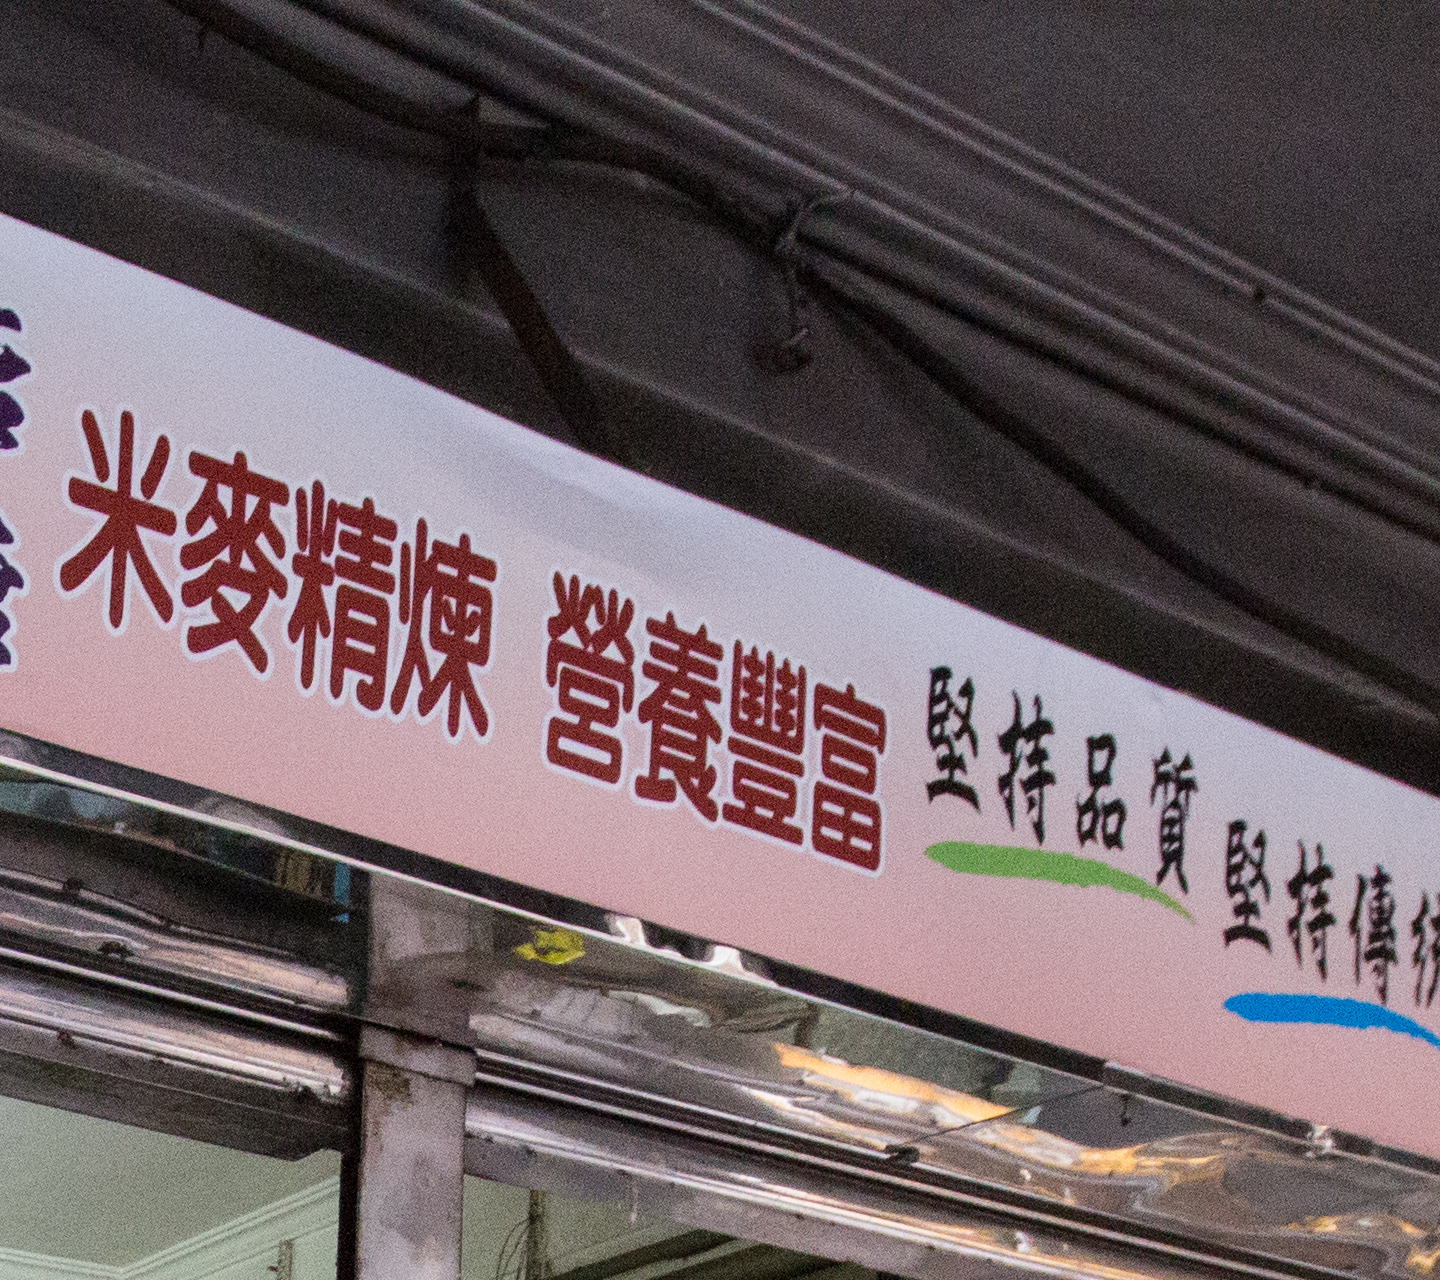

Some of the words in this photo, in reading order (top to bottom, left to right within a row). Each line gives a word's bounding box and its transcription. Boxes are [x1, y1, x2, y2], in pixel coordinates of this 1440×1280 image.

[60, 409, 498, 738] 米麥精煉
[546, 571, 888, 873] 營養豐富
[924, 666, 1199, 895] 堅持品質
